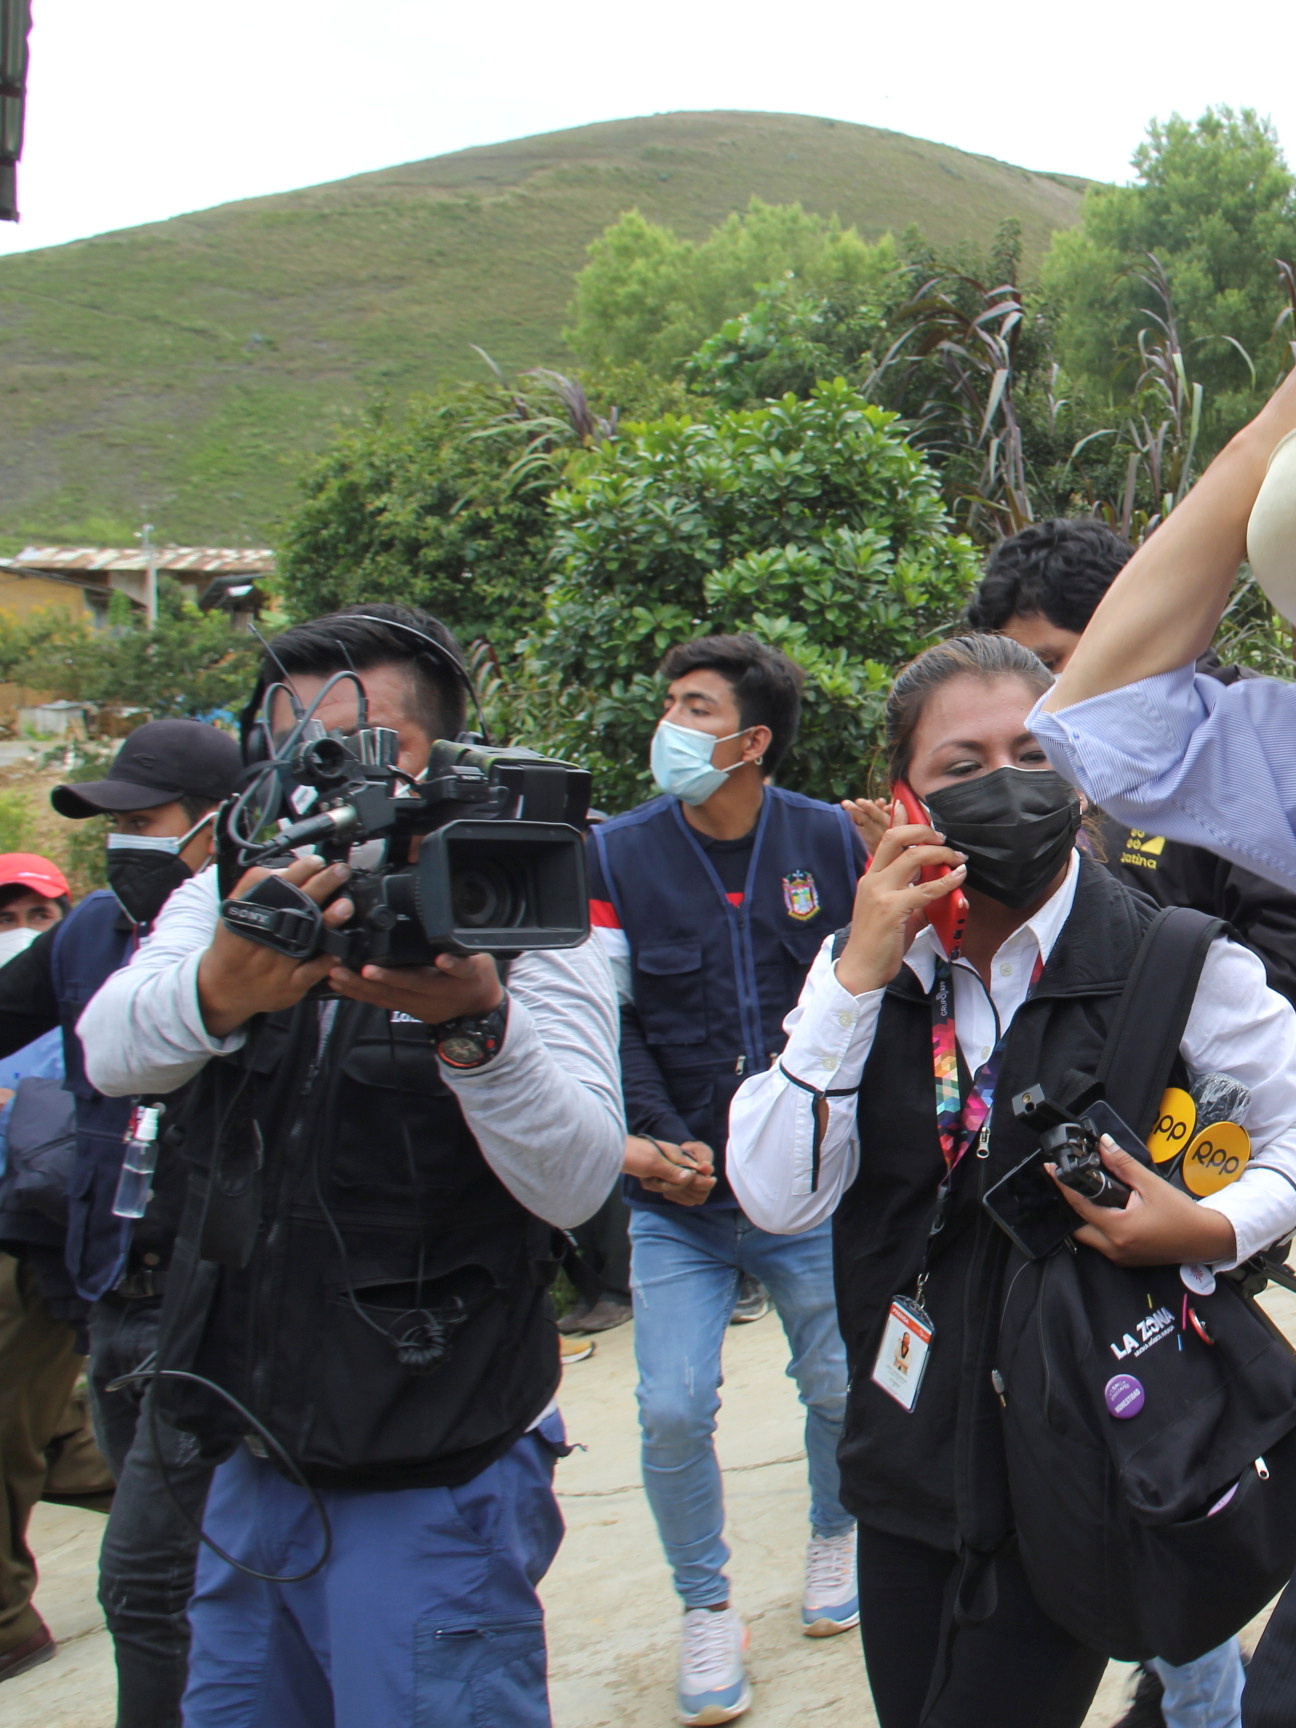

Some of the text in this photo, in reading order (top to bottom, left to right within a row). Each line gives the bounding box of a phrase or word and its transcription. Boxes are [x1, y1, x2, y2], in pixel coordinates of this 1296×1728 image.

[228, 907, 269, 923] SONY
[940, 994, 948, 1016] GRUPO
[1110, 1333, 1140, 1360] LA
[1136, 1306, 1175, 1342] ZONA
